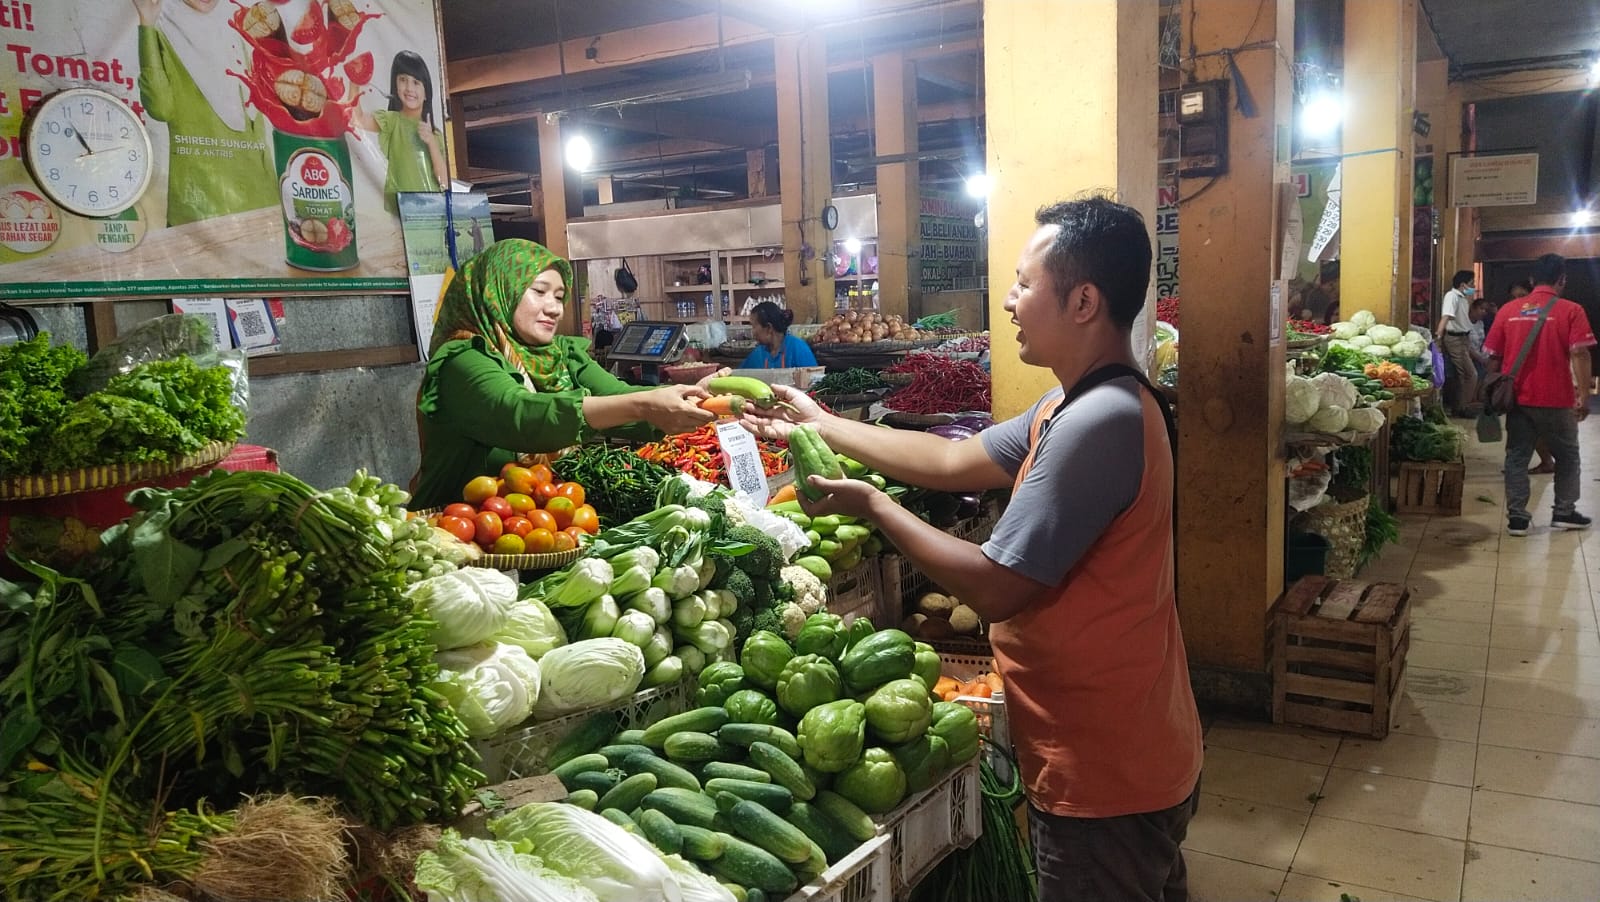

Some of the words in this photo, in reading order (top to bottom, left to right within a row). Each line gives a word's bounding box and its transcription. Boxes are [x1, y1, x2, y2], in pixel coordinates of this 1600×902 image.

[6, 44, 134, 90] Tomat,
[62, 106, 72, 119] 11
[80, 102, 95, 116] 12
[46, 121, 61, 135] 10
[120, 127, 129, 139] 2
[174, 134, 218, 146] SHIREEN
[219, 139, 265, 151] SUNGKAR
[40, 143, 51, 156] 9
[127, 149, 138, 162] 3
[176, 146, 192, 155] IBU
[203, 149, 234, 158] AKTRIS
[49, 168, 60, 181] 8
[124, 170, 134, 184] 4
[303, 168, 328, 181] ABC
[69, 184, 79, 198] 7
[88, 190, 99, 203] 6
[108, 185, 119, 199] 5
[291, 182, 341, 200] SARDINES
[304, 206, 334, 215] TOMAT
[14, 222, 39, 232] LEZAT
[41, 222, 58, 232] DARI
[104, 222, 129, 233] TANPA
[28, 232, 53, 242] SEGAR
